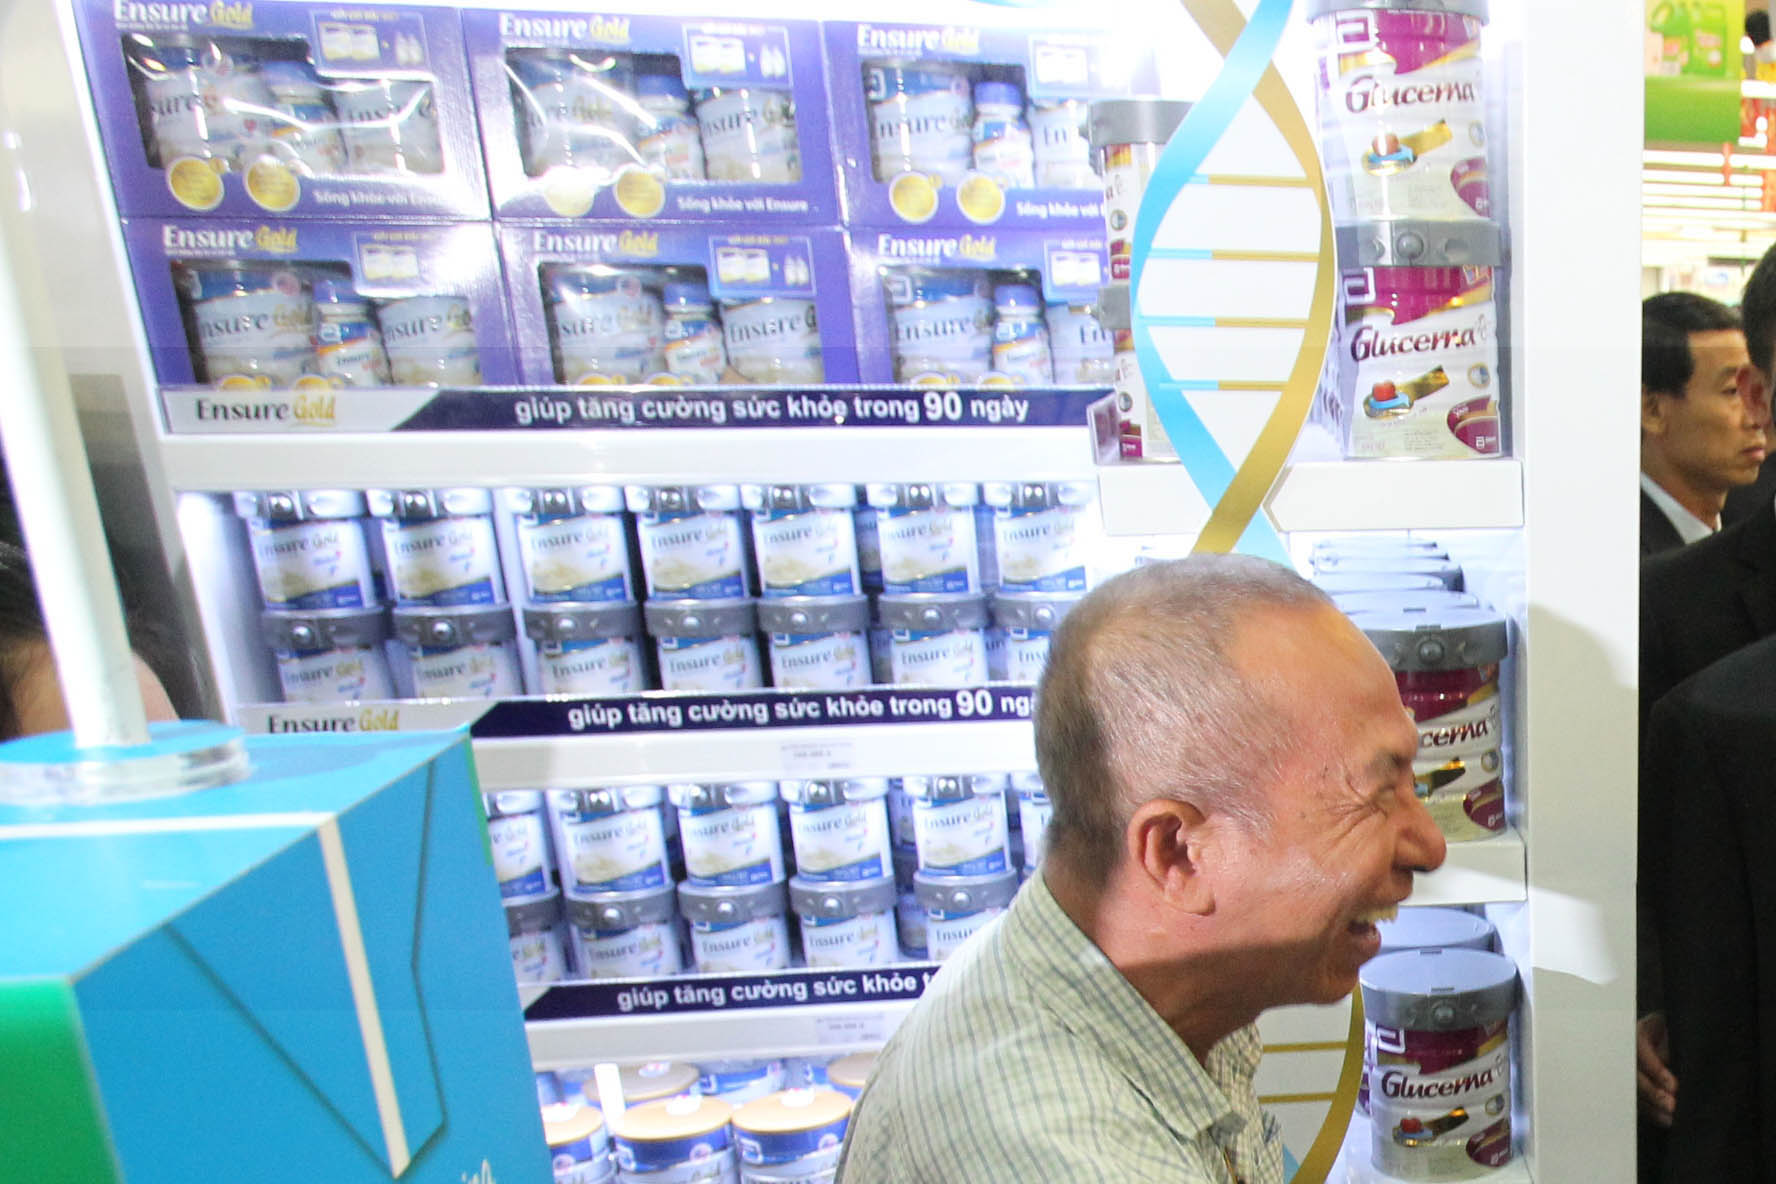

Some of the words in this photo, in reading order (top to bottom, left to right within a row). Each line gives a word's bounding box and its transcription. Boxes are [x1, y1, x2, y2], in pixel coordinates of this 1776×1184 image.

[114, 0, 207, 24] Ensure
[500, 13, 587, 38] Ensure
[590, 16, 631, 43] Gold
[857, 24, 940, 50] Ensure
[164, 226, 253, 248] Ensure
[256, 227, 297, 253] Gold
[534, 232, 617, 252] Ensure
[618, 230, 659, 257] Gold
[878, 235, 957, 256] Ensure
[959, 234, 996, 260] Gold
[1351, 326, 1475, 362] Glucerna
[196, 398, 288, 421] Ensure
[294, 394, 336, 426] Gold
[515, 397, 571, 424] giúp
[579, 398, 635, 424] tăng
[642, 397, 726, 424] cường
[733, 396, 780, 418] sức
[788, 395, 847, 418] khỏe
[854, 397, 920, 421] trong
[924, 391, 962, 420] 90
[971, 398, 1029, 424] ngày
[268, 714, 355, 733] Ensure
[359, 707, 400, 731] Gold
[568, 706, 623, 730] giúp
[628, 702, 682, 727] tăng
[689, 700, 768, 724] cường
[775, 694, 820, 718] sức
[827, 694, 883, 717] khỏe
[890, 695, 951, 719] trong
[956, 690, 992, 715] 90
[1001, 695, 1034, 719] ng
[1421, 717, 1489, 747] cerna
[618, 986, 668, 1011] giúp
[674, 983, 726, 1008] tăng
[731, 976, 808, 1003] cường
[813, 975, 857, 996] sức
[863, 973, 917, 994] khỏe
[1381, 1069, 1493, 1099] Glucerna
